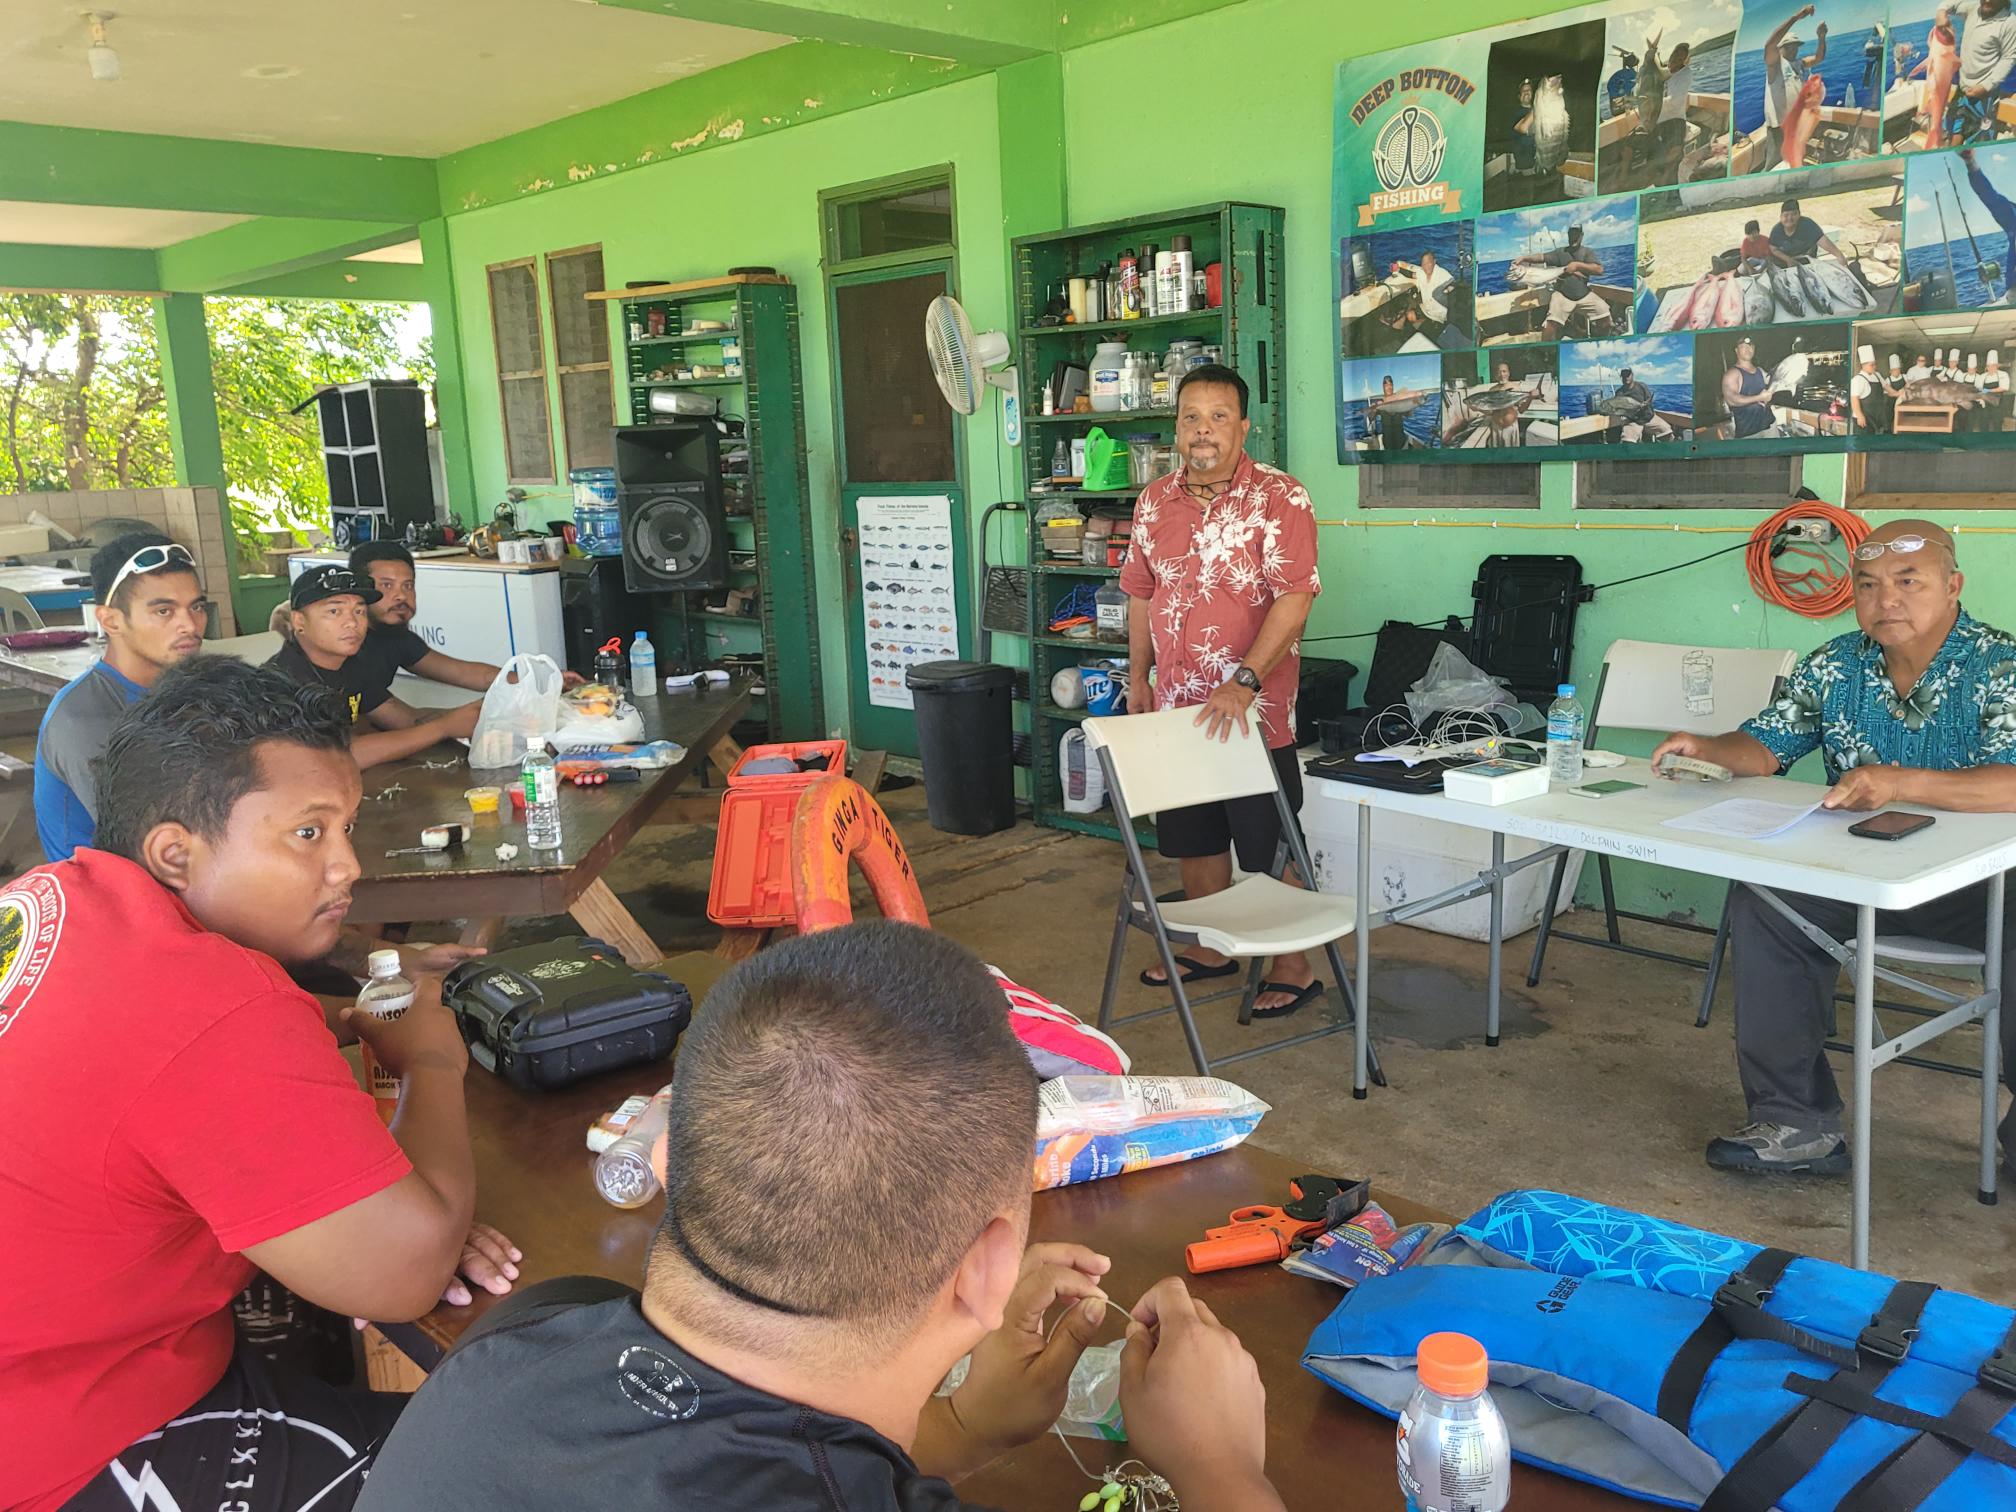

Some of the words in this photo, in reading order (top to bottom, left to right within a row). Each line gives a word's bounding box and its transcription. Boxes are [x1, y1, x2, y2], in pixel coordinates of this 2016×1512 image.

[1351, 78, 1395, 126] DEEP
[1399, 68, 1476, 106] BOTTOM
[1372, 185, 1445, 211] FISHING
[832, 796, 859, 855] GINGA
[871, 808, 910, 880] TIGER
[1580, 831, 1621, 851] DOLPHIN
[1626, 844, 1657, 862] SWIM
[38, 924, 56, 944] OF
[18, 946, 49, 988] LIFE
